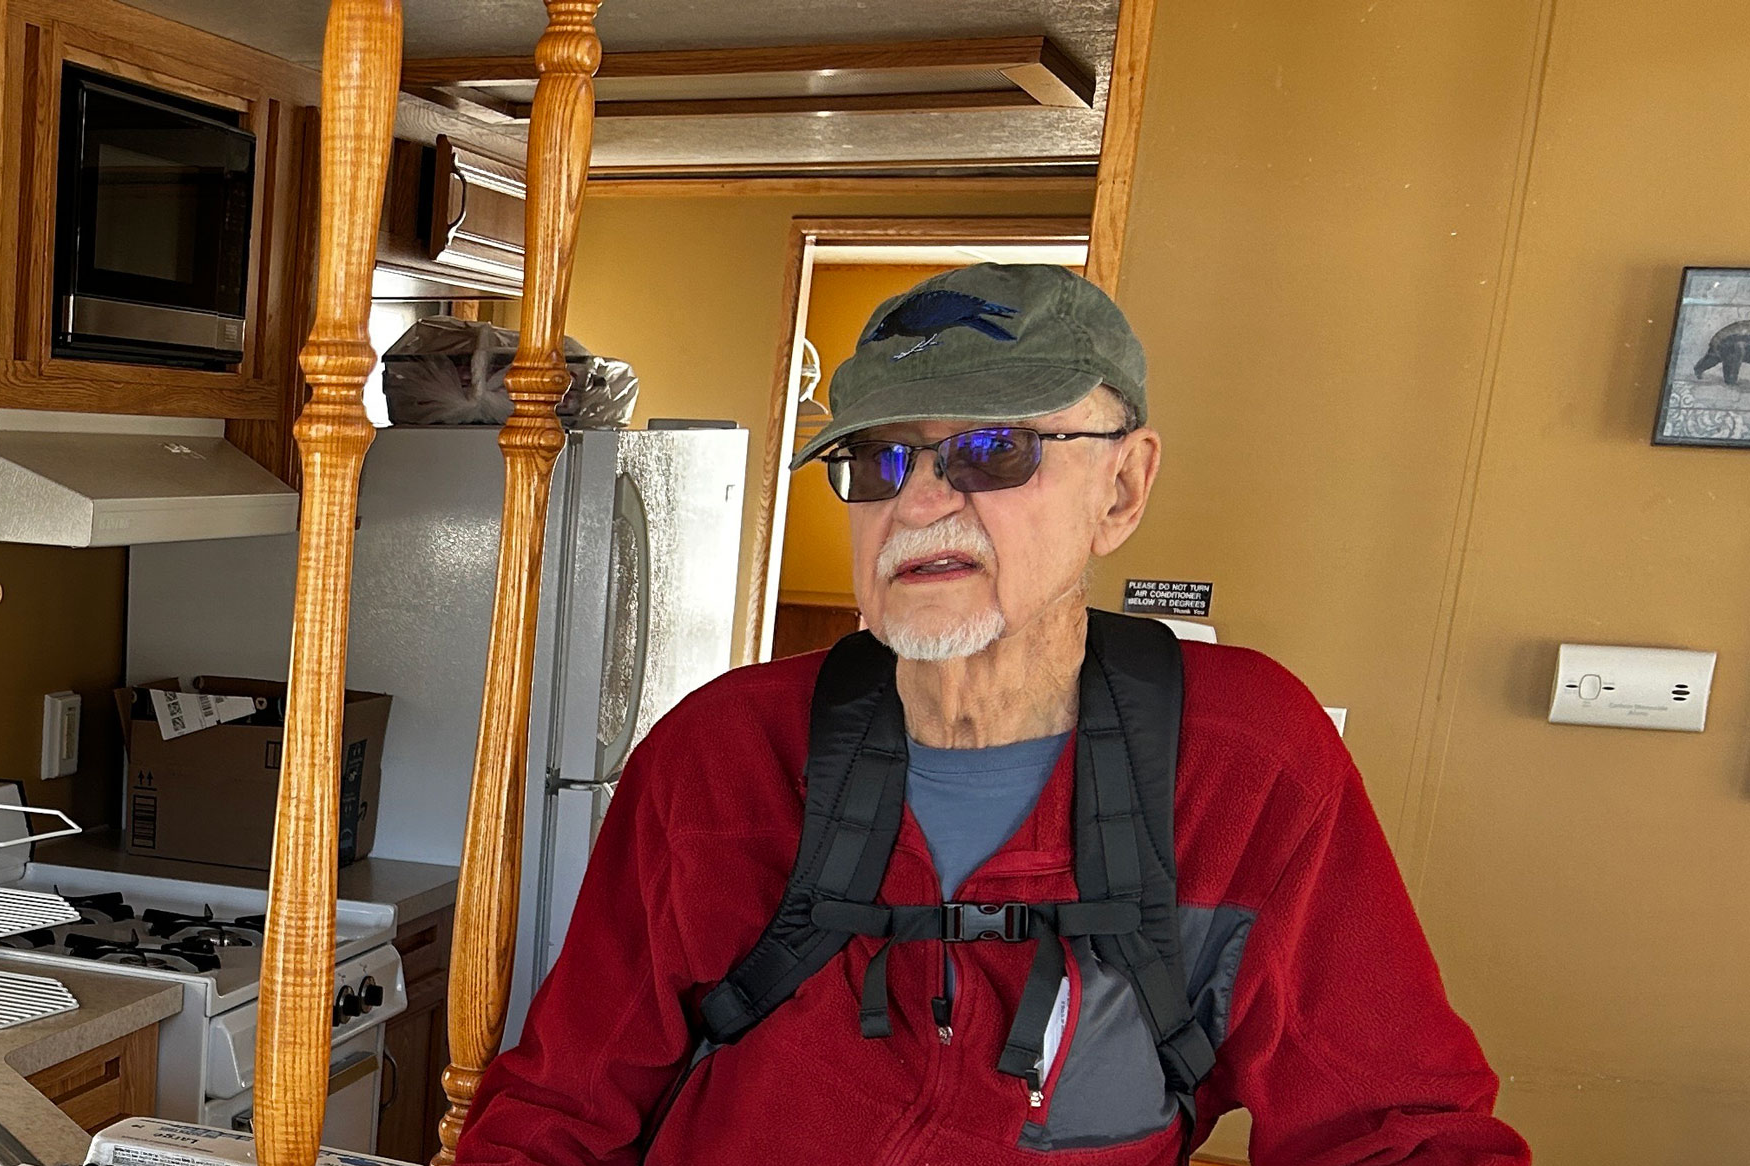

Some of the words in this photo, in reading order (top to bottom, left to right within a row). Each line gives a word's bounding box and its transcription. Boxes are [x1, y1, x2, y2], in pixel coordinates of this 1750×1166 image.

[1128, 581, 1157, 590] PLEASE
[1190, 584, 1210, 592] TURN
[1149, 590, 1202, 600] CONDITIONER
[1128, 598, 1156, 606] BELOW
[1157, 599, 1167, 607] 72
[1169, 600, 1206, 608] DEGREES
